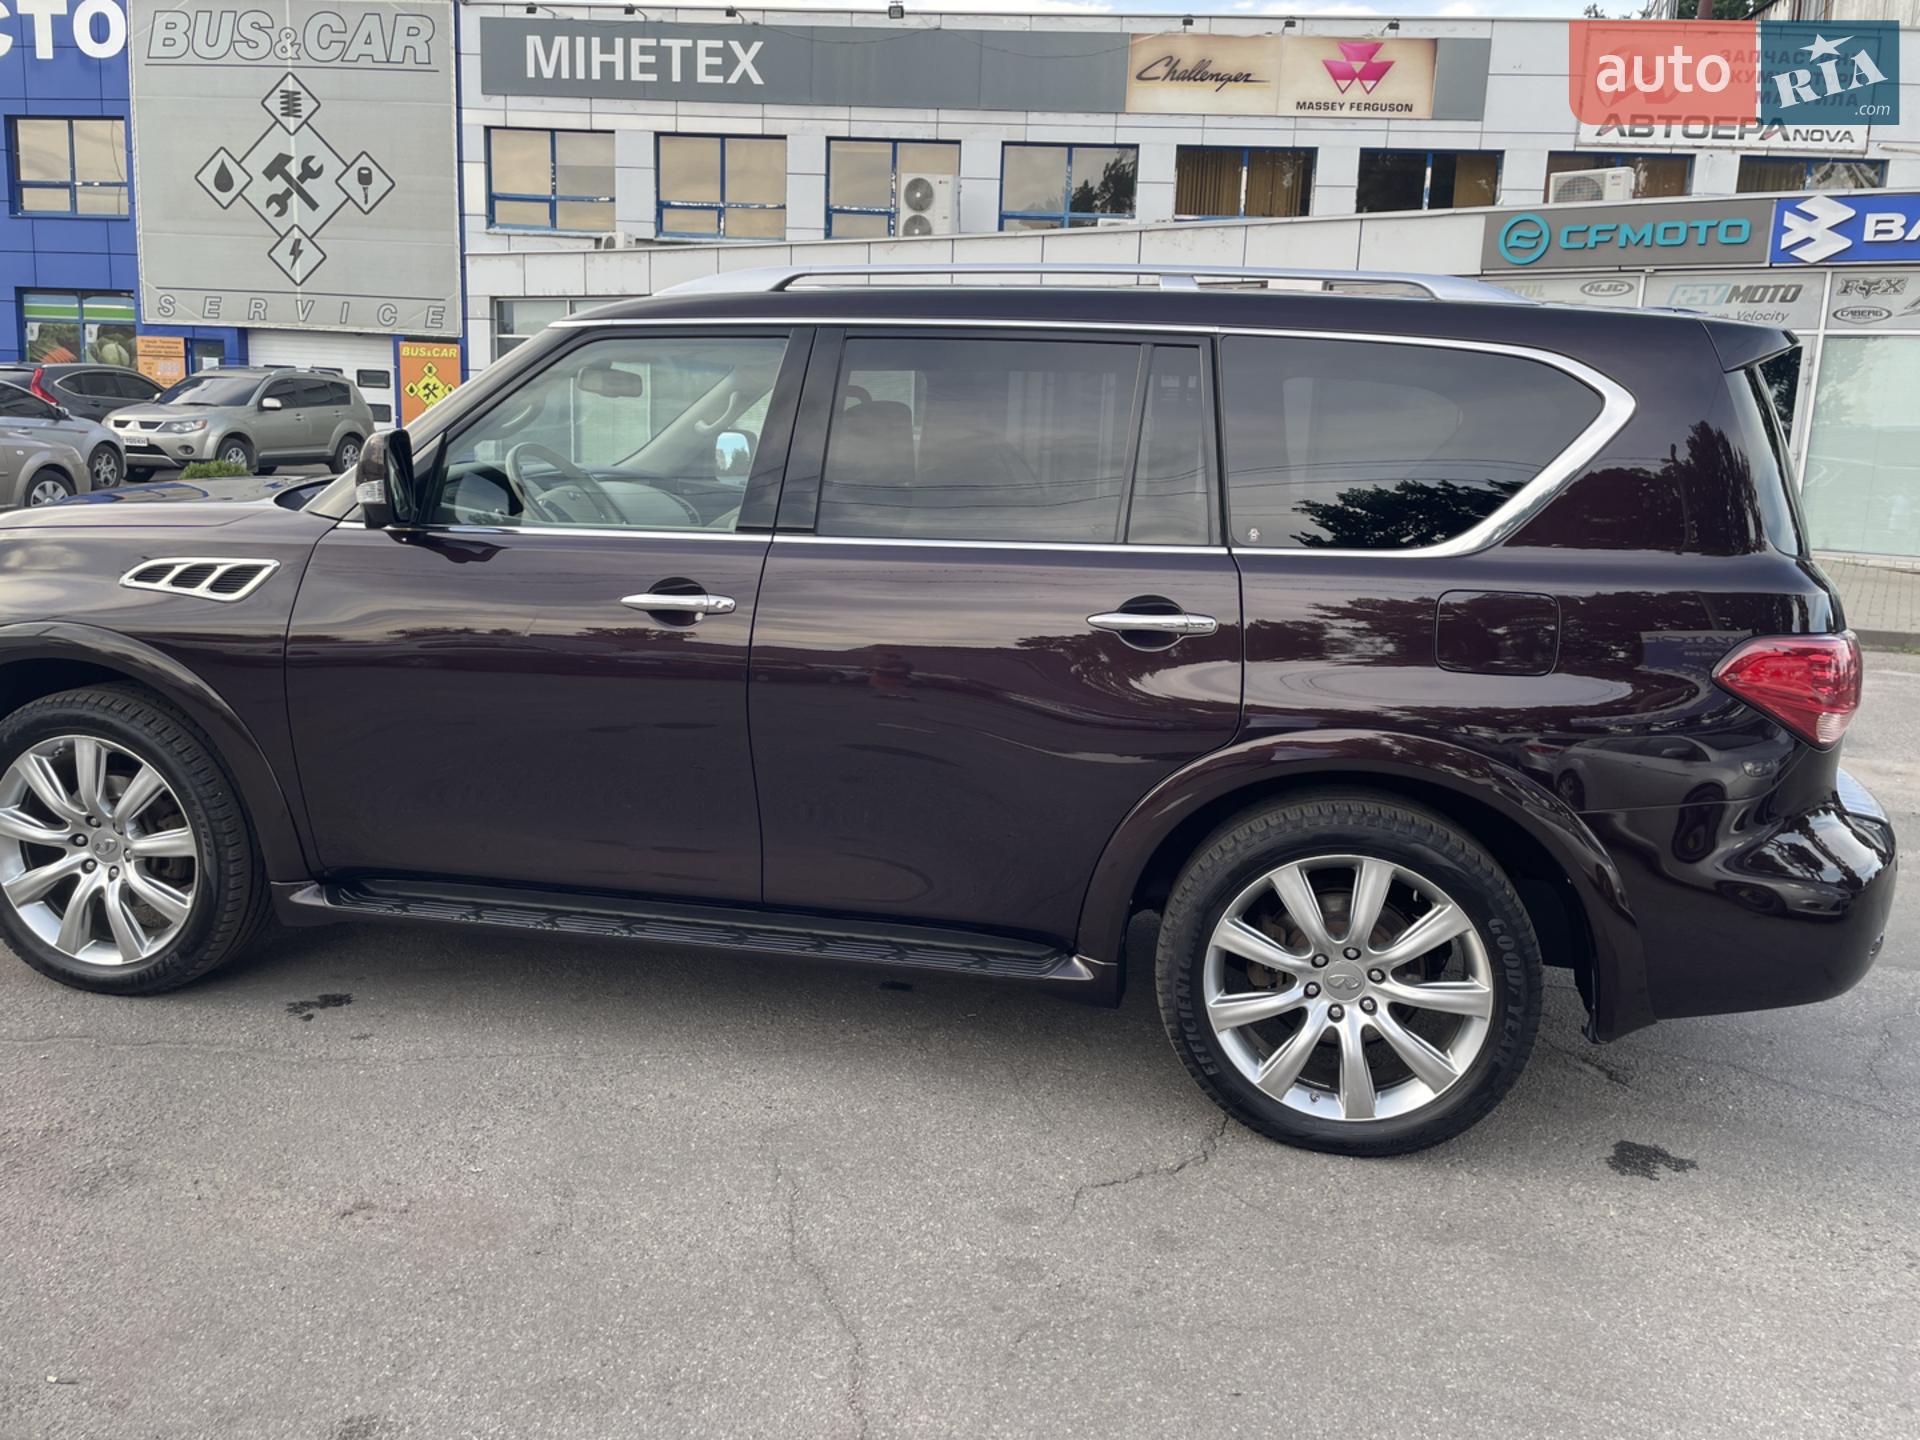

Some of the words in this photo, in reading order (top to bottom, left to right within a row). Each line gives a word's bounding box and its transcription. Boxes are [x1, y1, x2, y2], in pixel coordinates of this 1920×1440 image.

[0, 0, 126, 60] ТО
[147, 9, 436, 65] BUS&CAR
[525, 34, 765, 85] MIHETEX
[1135, 55, 1271, 93] Challenger
[1295, 100, 1345, 112] MASSEY
[1349, 101, 1413, 113] FERGUSON
[1792, 128, 1855, 143] NOVA
[1558, 217, 1752, 249] CFMOTO
[1587, 282, 1626, 293] HJC
[157, 294, 446, 329] SERVICE
[1736, 309, 1790, 324] Velocity
[401, 346, 458, 358] BUS&CAR
